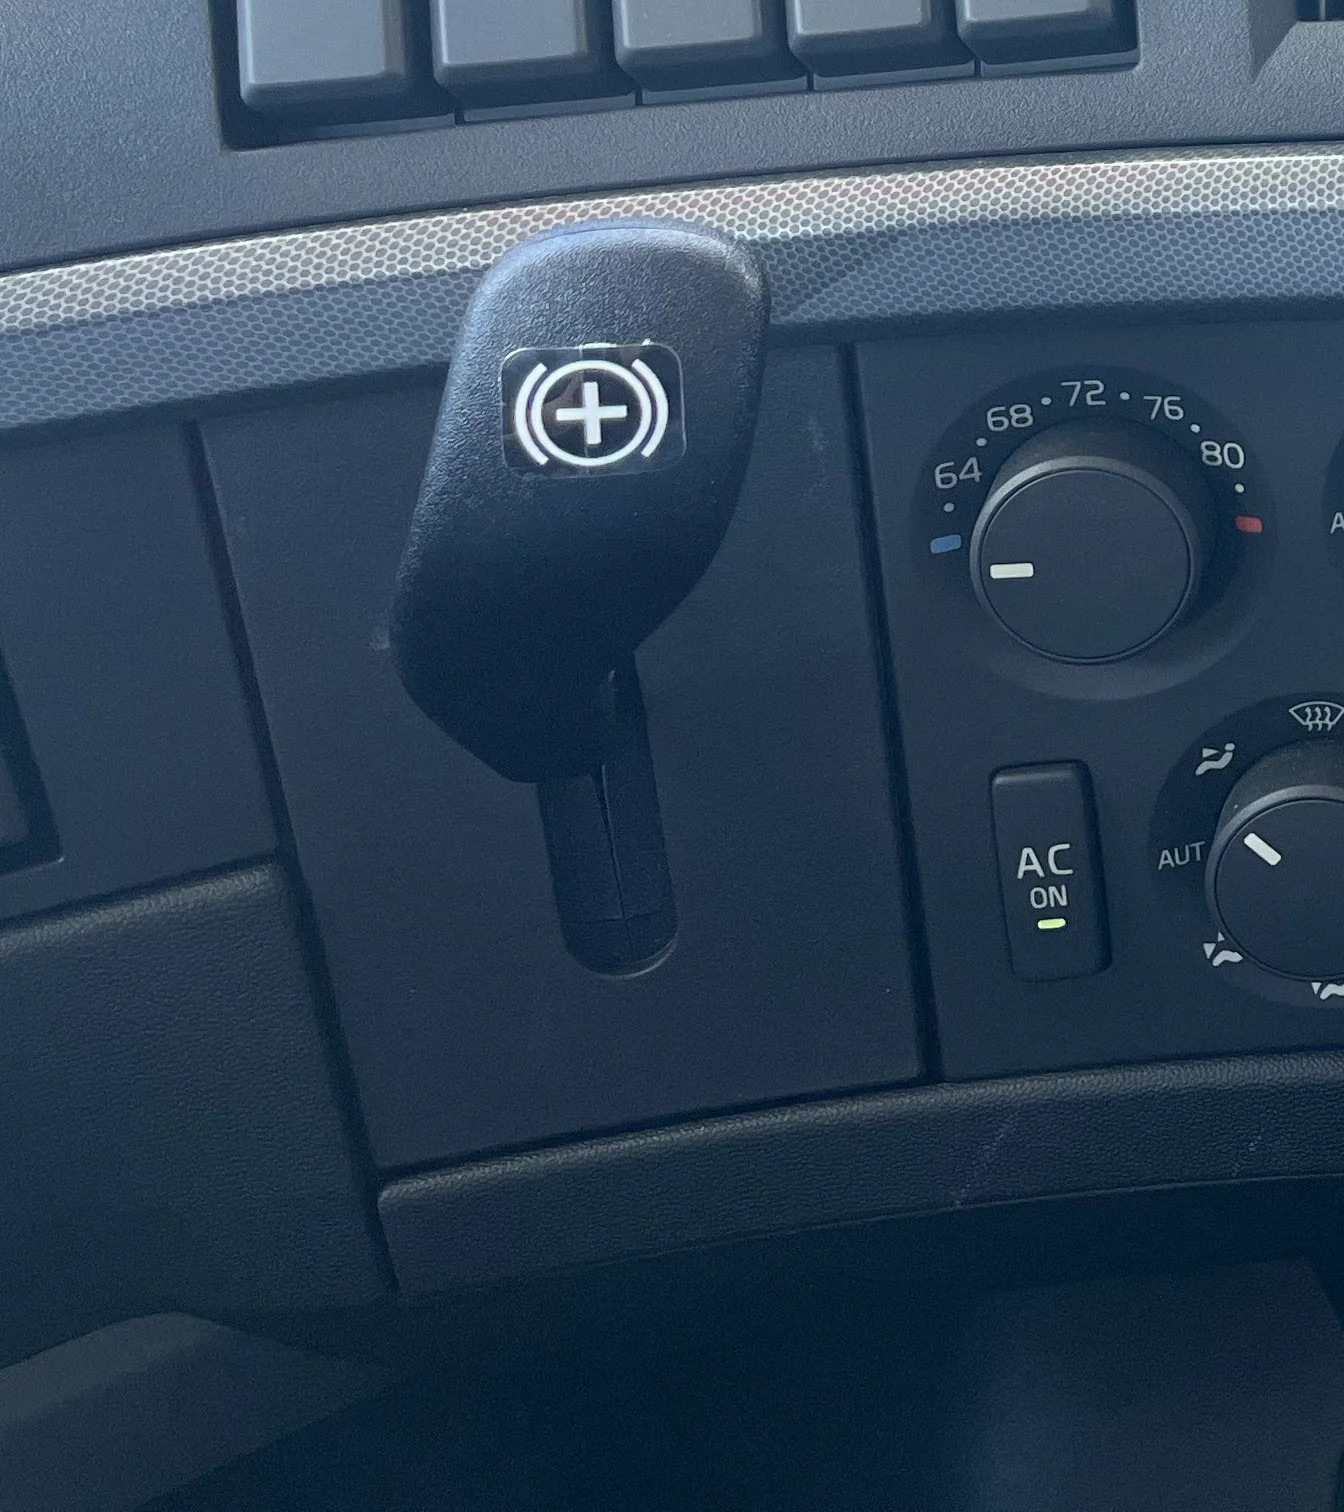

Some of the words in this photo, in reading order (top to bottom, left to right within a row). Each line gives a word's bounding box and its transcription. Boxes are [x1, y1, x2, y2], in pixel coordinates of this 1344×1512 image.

[1061, 380, 1106, 406] 72
[986, 404, 1034, 431] 68
[1143, 395, 1184, 420] 76
[1200, 441, 1245, 469] 80
[934, 456, 982, 489] 64
[1017, 843, 1073, 879] AC
[1158, 840, 1205, 870] AUT
[1030, 884, 1068, 908] ON
